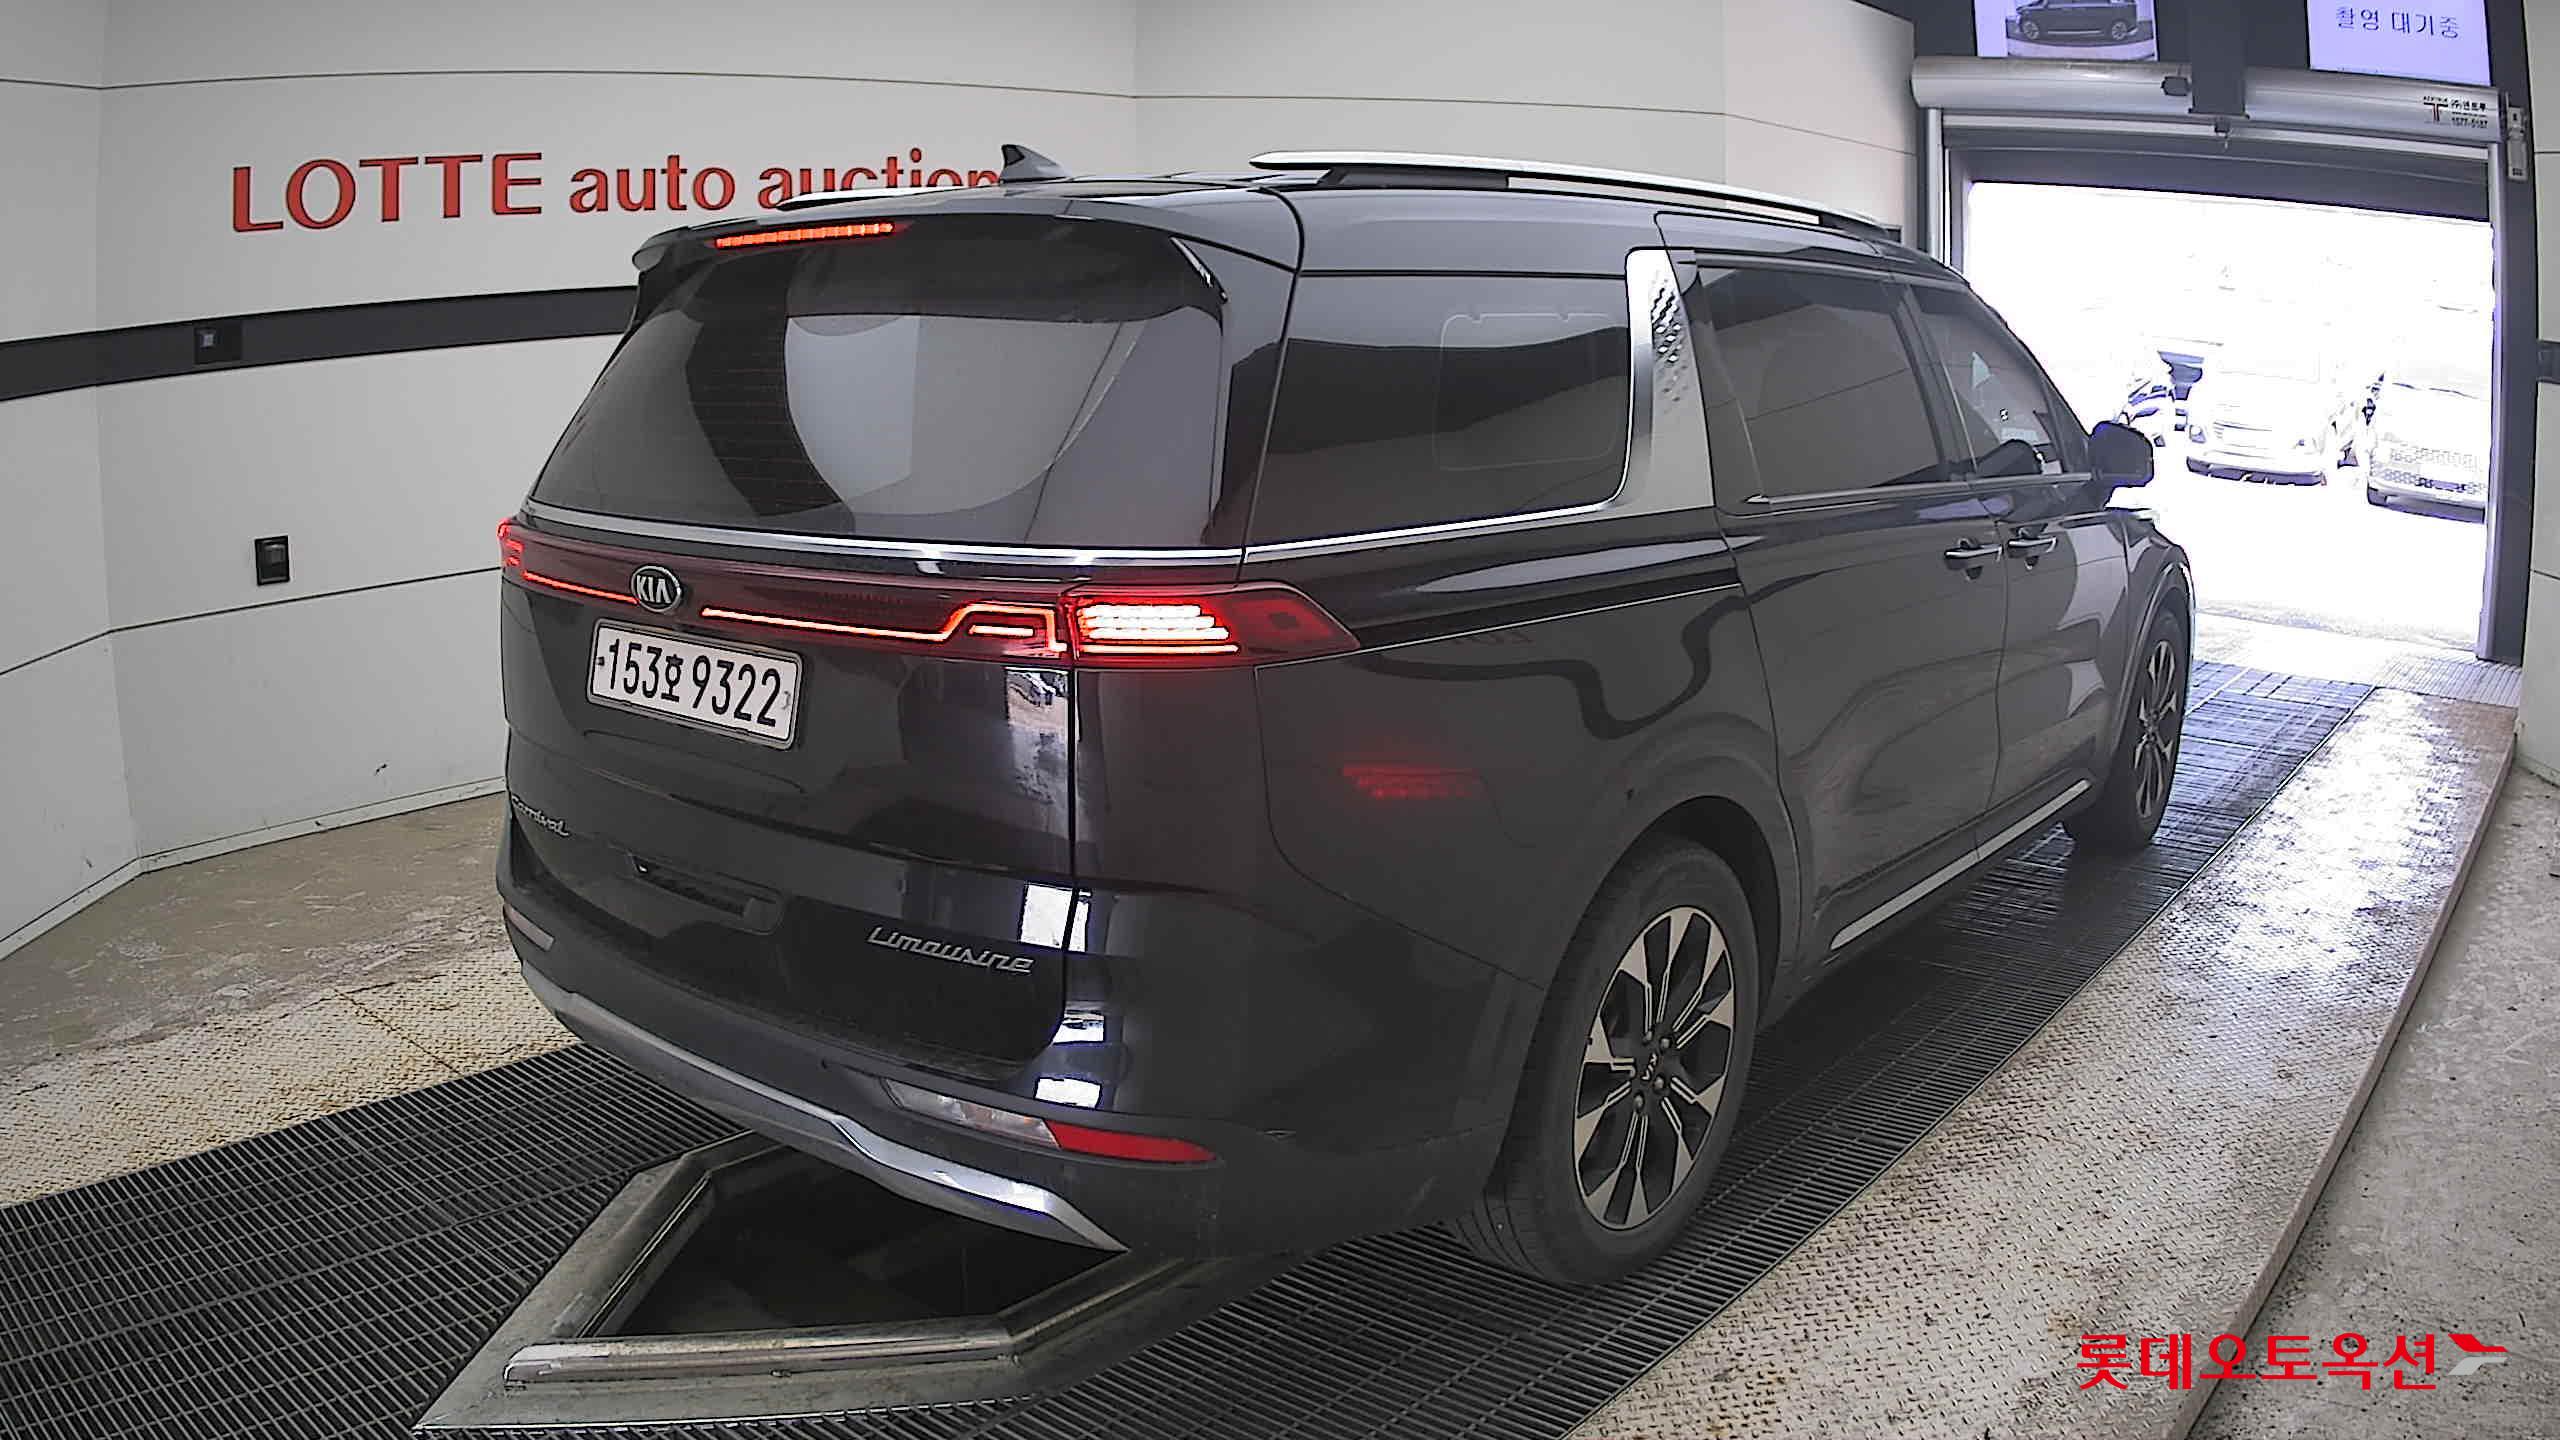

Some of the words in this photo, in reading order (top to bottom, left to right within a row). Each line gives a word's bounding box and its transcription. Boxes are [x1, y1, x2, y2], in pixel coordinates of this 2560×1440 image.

[233, 152, 542, 233] LOTTE
[569, 154, 736, 213] auto
[636, 574, 672, 604] KIA
[609, 638, 684, 702] 153호
[692, 655, 781, 727] 9322
